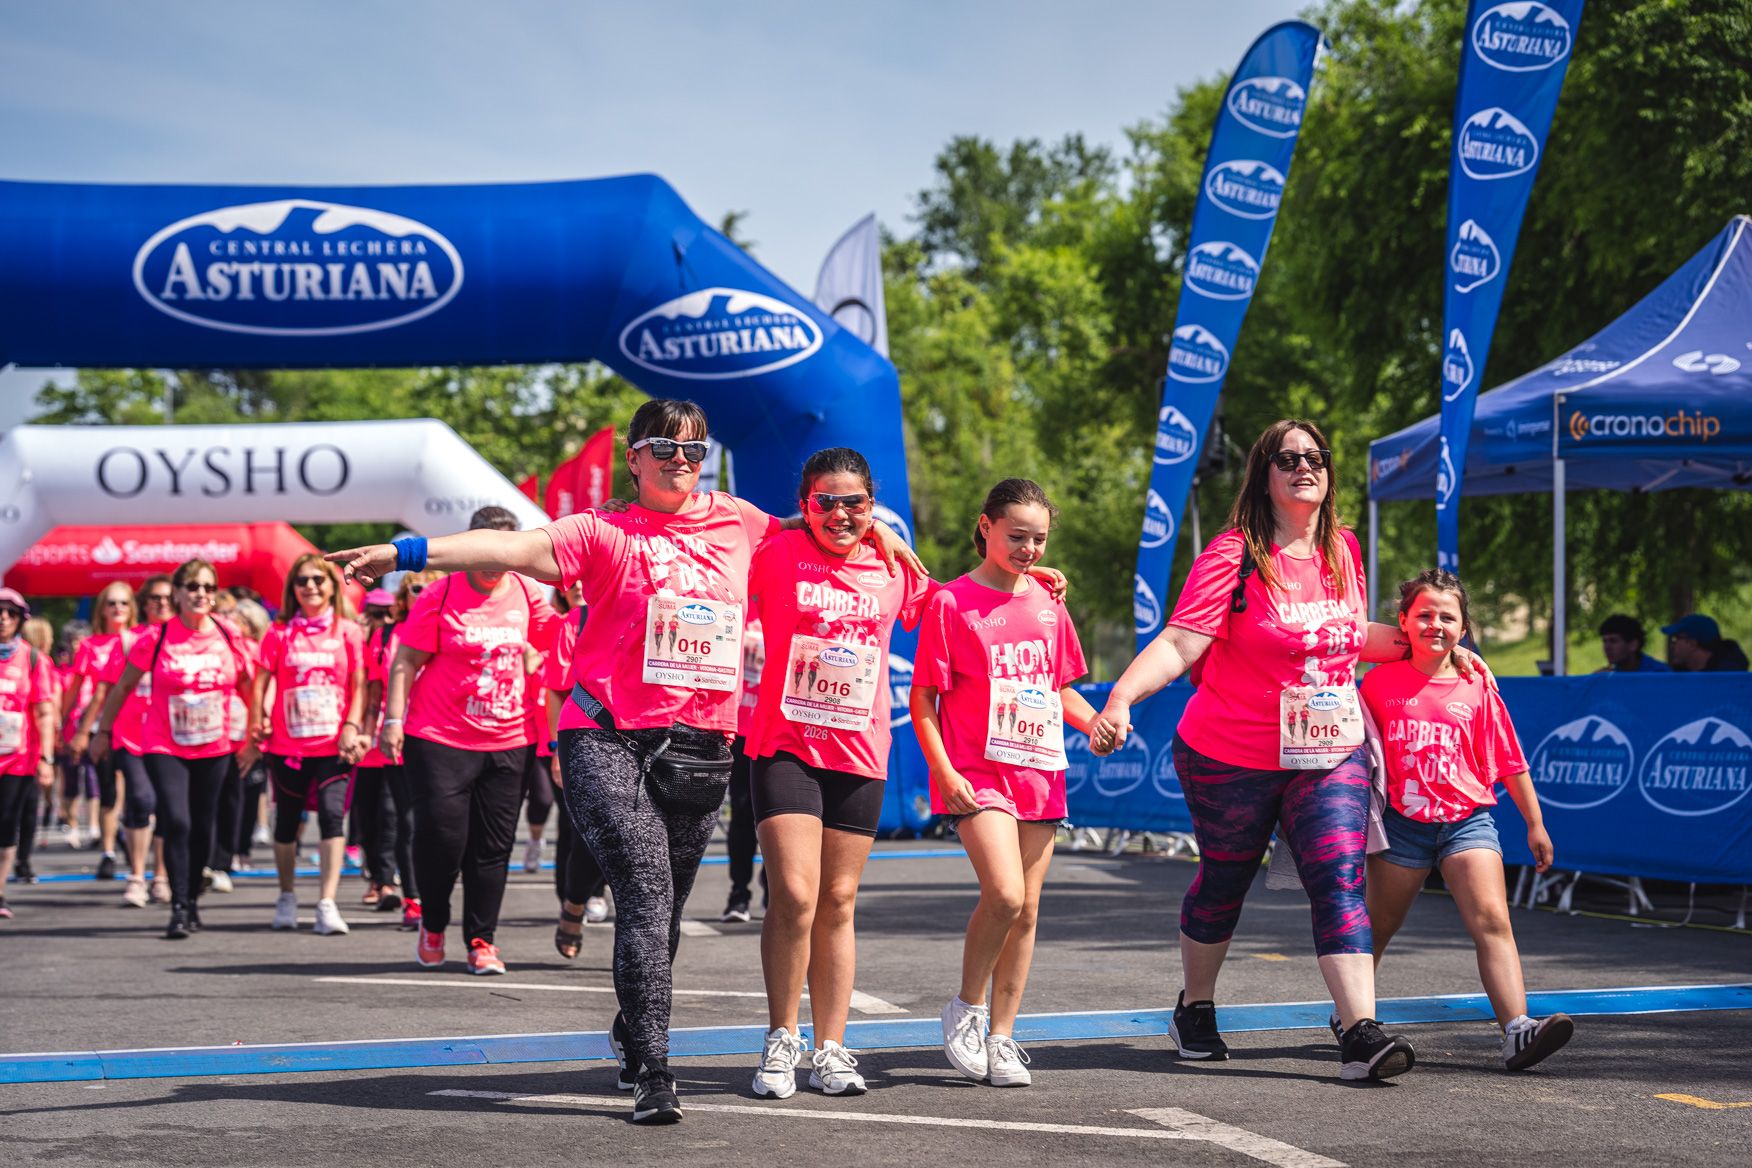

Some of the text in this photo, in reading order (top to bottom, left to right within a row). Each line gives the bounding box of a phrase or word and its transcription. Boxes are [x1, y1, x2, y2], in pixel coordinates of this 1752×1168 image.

[209, 239, 427, 257] CENTRAL LECHERA
[161, 242, 439, 301] ASTURIANA
[638, 325, 812, 361] ASTURIANA
[1590, 409, 1721, 441] cronochip
[95, 445, 351, 499] OYSHO
[122, 540, 240, 564] Santander
[799, 582, 880, 619] CARRERA
[1278, 599, 1350, 624] CARRERA
[968, 616, 1007, 631] OYSHO
[678, 638, 711, 655] 016
[655, 671, 685, 681] OYSHO
[817, 679, 851, 696] 016
[1385, 697, 1418, 708] OYSHO
[791, 708, 821, 720] OYSHO
[804, 724, 828, 740] 2026
[1017, 720, 1044, 737] 016
[1310, 725, 1339, 738] 016
[1387, 718, 1461, 749] CARRERA
[1290, 757, 1319, 765] OYSHO
[1534, 750, 1623, 787] ASTURIANA
[1646, 752, 1747, 791] ASTURIANA
